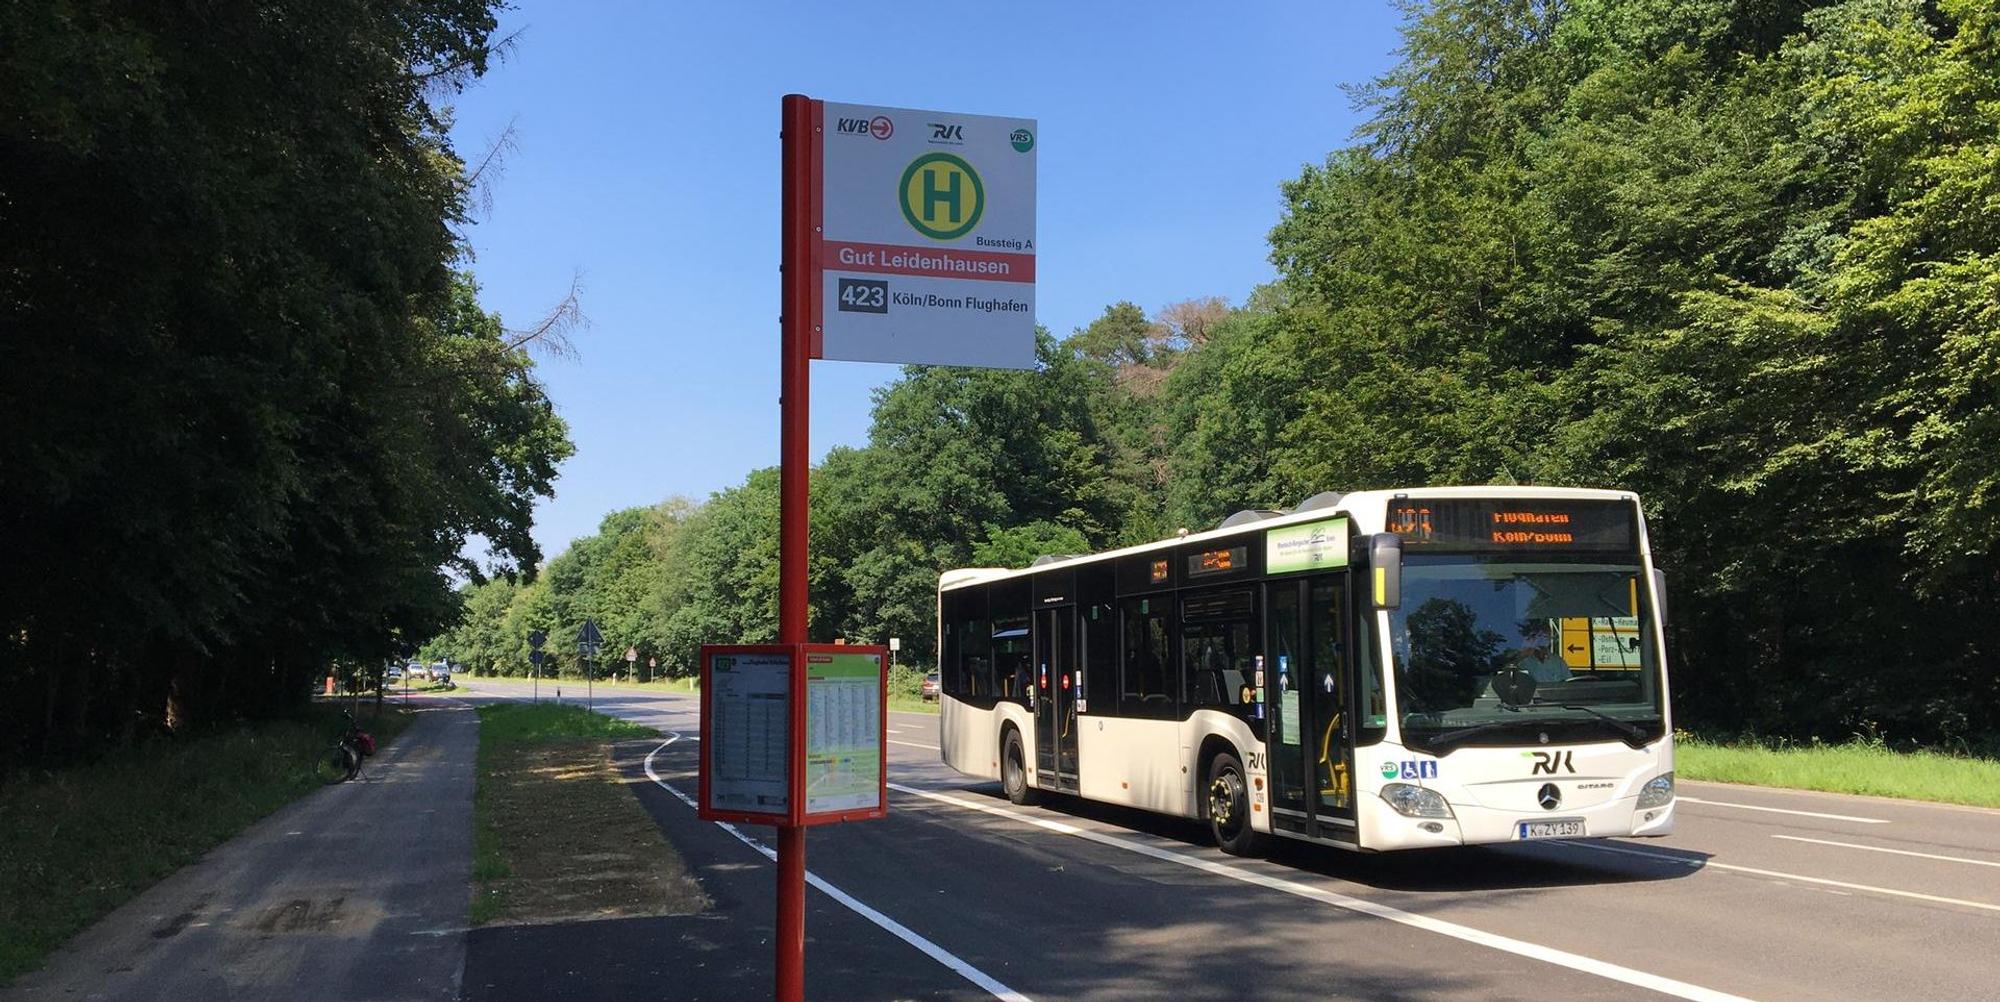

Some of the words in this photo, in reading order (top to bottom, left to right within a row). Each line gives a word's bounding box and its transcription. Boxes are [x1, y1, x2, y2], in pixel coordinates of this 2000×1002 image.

[837, 118, 869, 134] KVB
[1009, 133, 1028, 143] VRS
[923, 169, 961, 223] H
[977, 236, 1022, 250] Bussteig
[1025, 239, 1033, 249] A
[839, 247, 875, 266] Gut
[881, 250, 1010, 274] Leidenhausen
[841, 284, 885, 307] 423
[893, 291, 962, 309] Köln/Bonn
[966, 297, 1029, 313] Flughafen
[1530, 823, 1537, 837] K
[1545, 823, 1558, 836] ZY
[1560, 821, 1580, 835] 139
